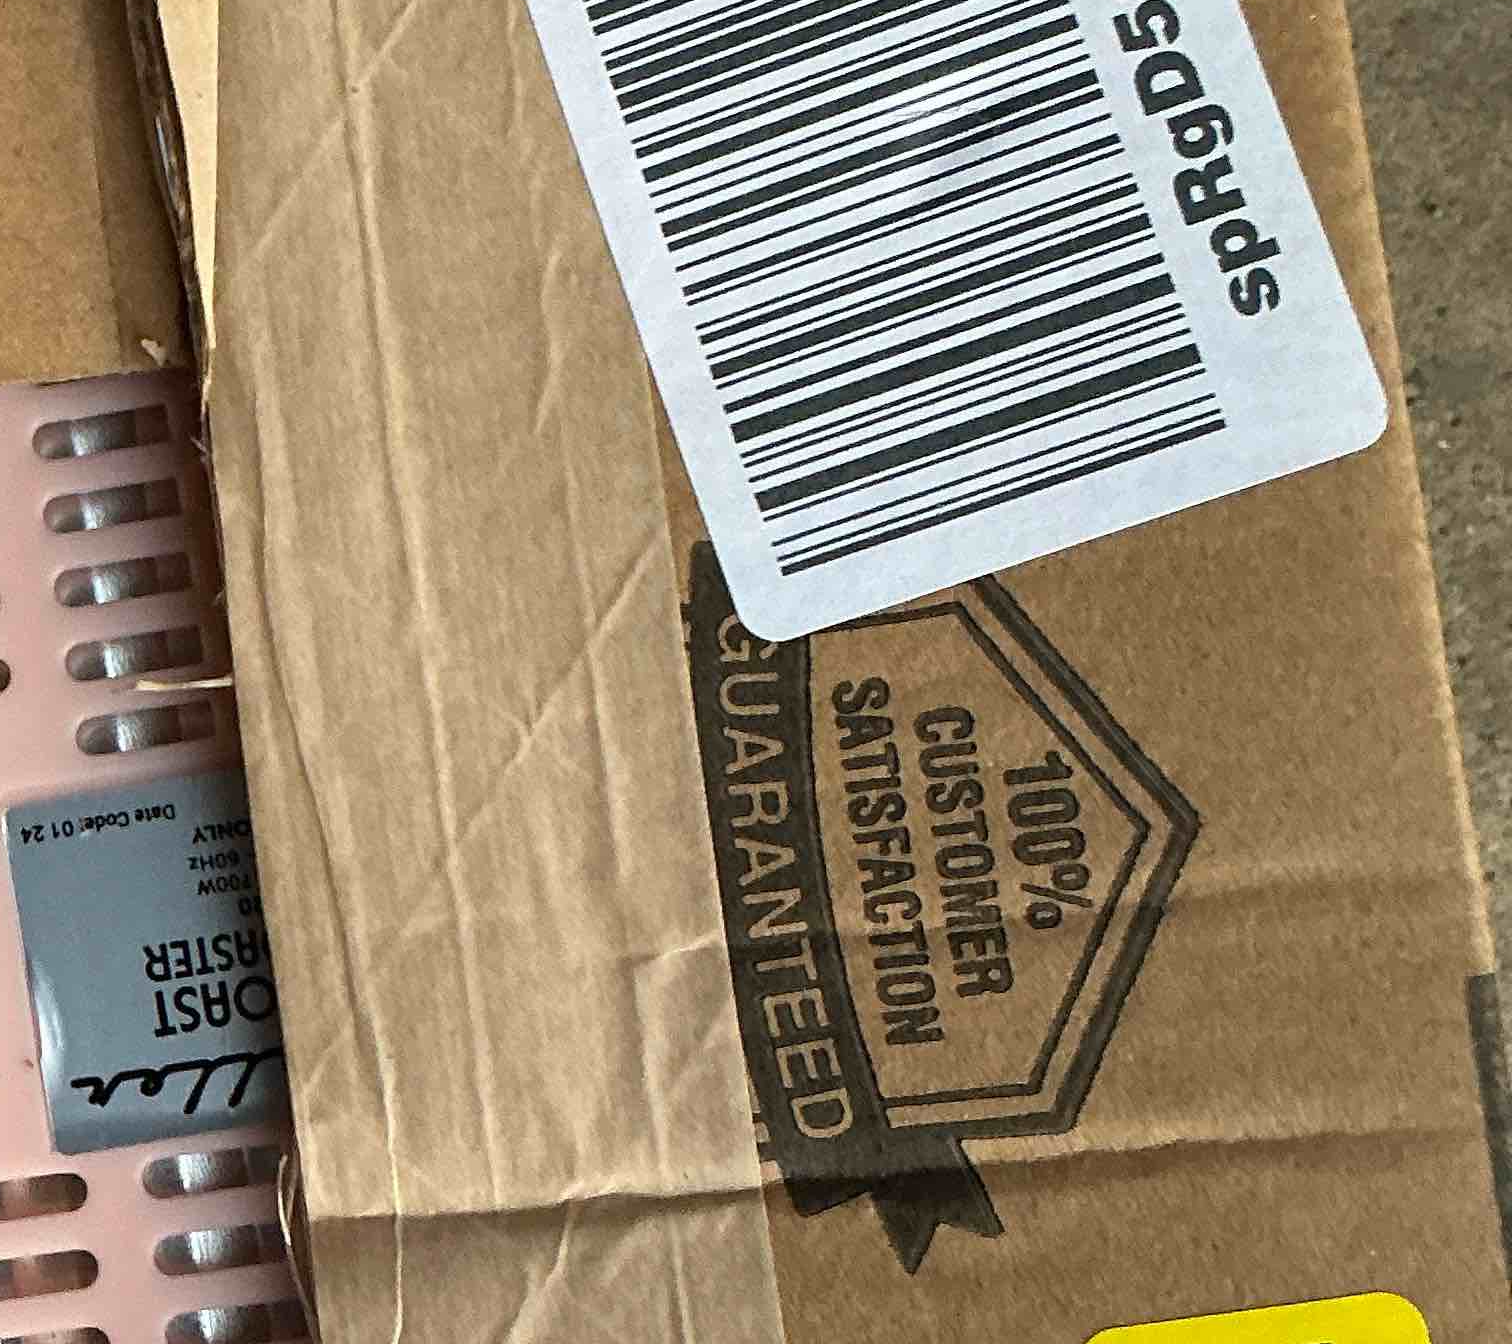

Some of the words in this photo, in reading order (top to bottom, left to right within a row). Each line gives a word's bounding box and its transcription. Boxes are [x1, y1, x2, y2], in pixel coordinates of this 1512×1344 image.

[21, 825, 44, 844] 24
[135, 804, 177, 822] Date
[716, 615, 853, 1139] GUARANTEED
[833, 677, 943, 1045] SATISFACTION
[914, 706, 1014, 998] CUSTOMER
[1004, 752, 1093, 930] 100%
[143, 928, 268, 982] ASTER
